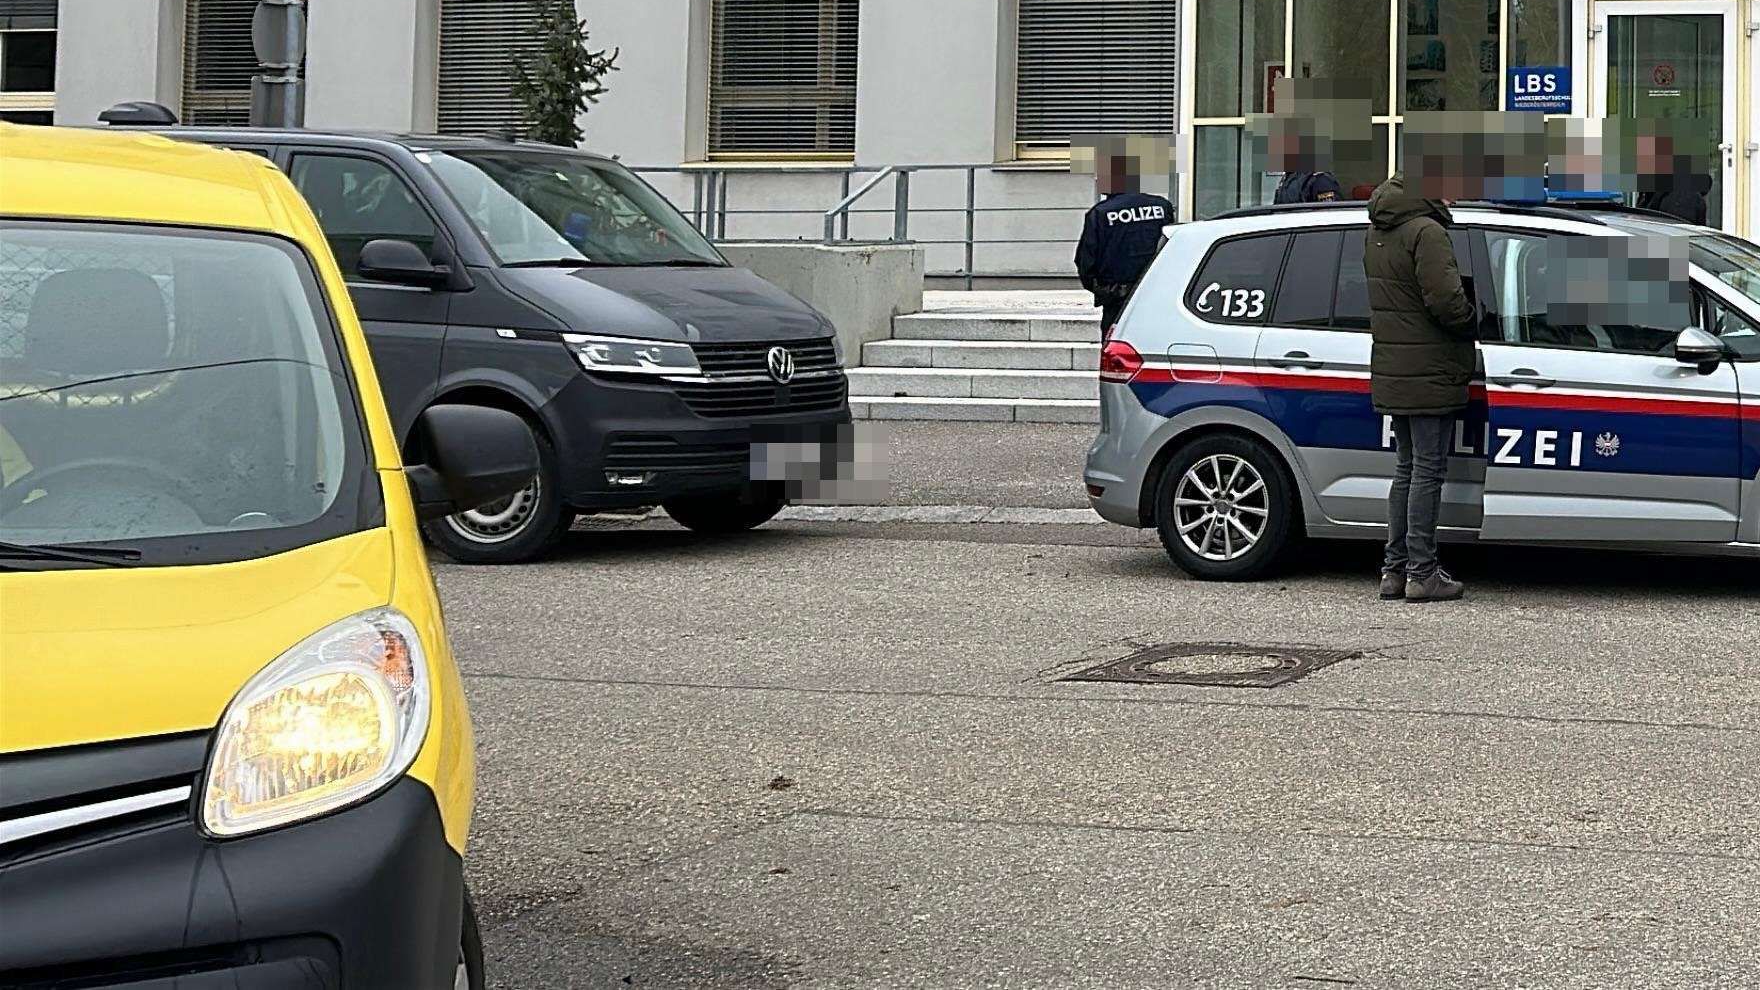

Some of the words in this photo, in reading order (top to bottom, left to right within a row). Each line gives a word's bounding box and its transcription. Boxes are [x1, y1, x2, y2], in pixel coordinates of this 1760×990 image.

[1514, 73, 1557, 93] LBS
[1106, 205, 1165, 226] POLIZEI
[1220, 289, 1266, 318] 133
